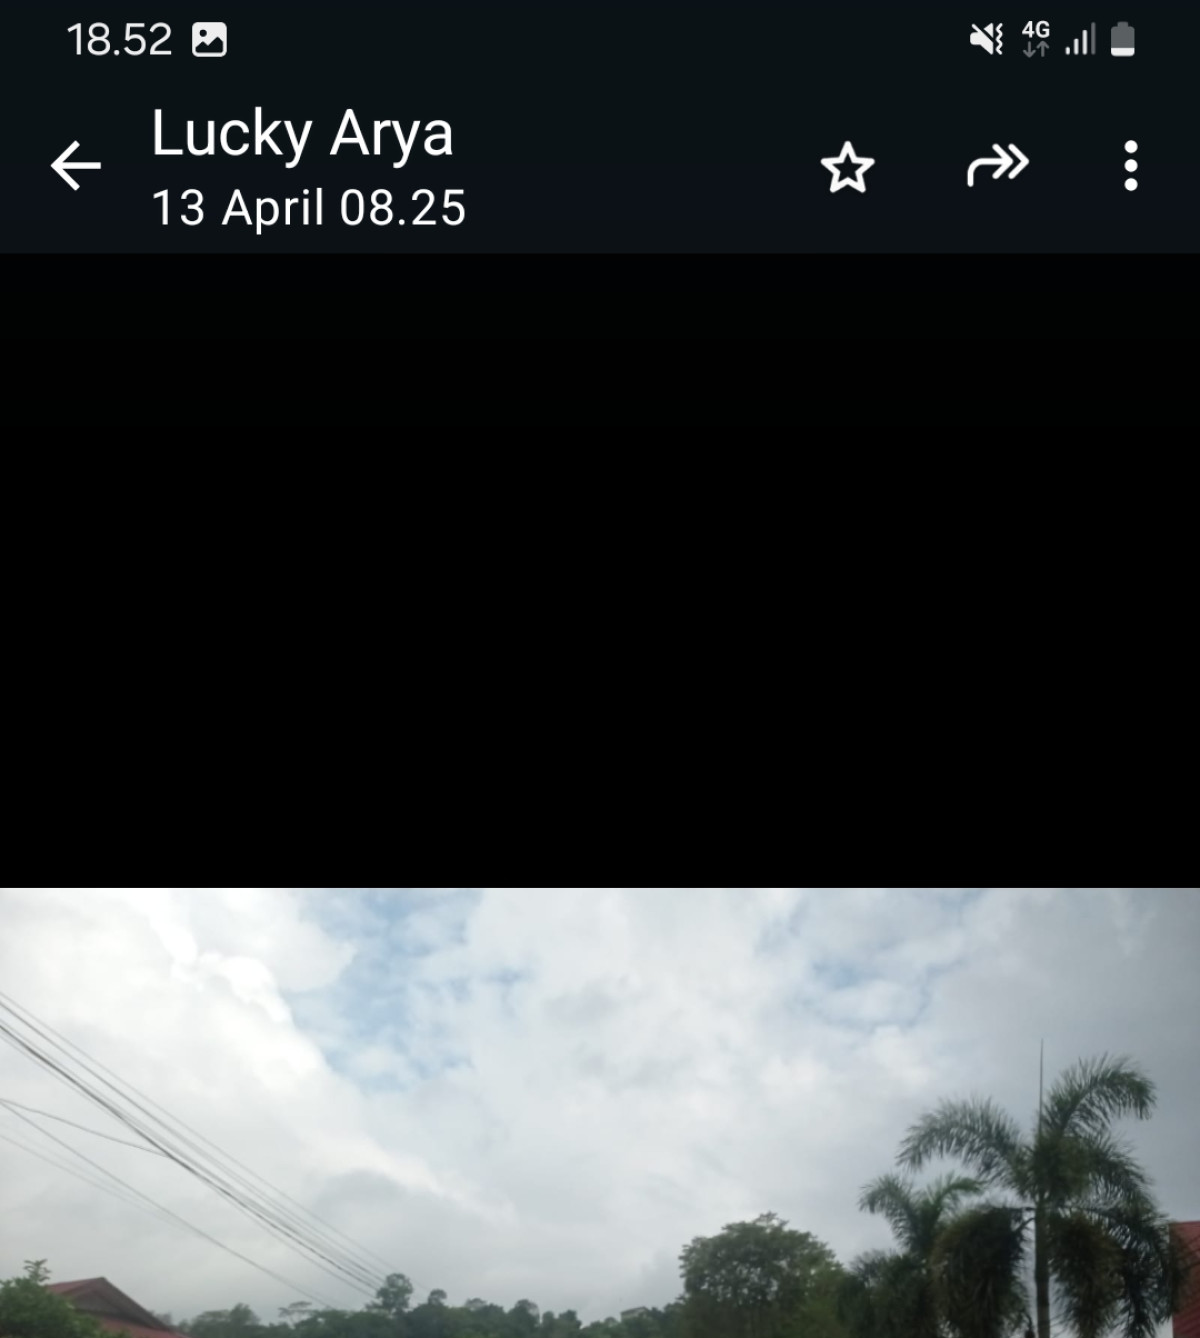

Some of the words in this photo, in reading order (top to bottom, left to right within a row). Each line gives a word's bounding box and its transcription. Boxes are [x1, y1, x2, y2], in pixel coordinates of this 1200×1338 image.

[67, 21, 172, 56] 18.52
[1021, 20, 1050, 39] 4G
[154, 106, 313, 165] Lucky
[329, 108, 453, 165] Arya
[153, 188, 204, 226] 13
[221, 187, 323, 236] April
[340, 188, 466, 226] 08.25
